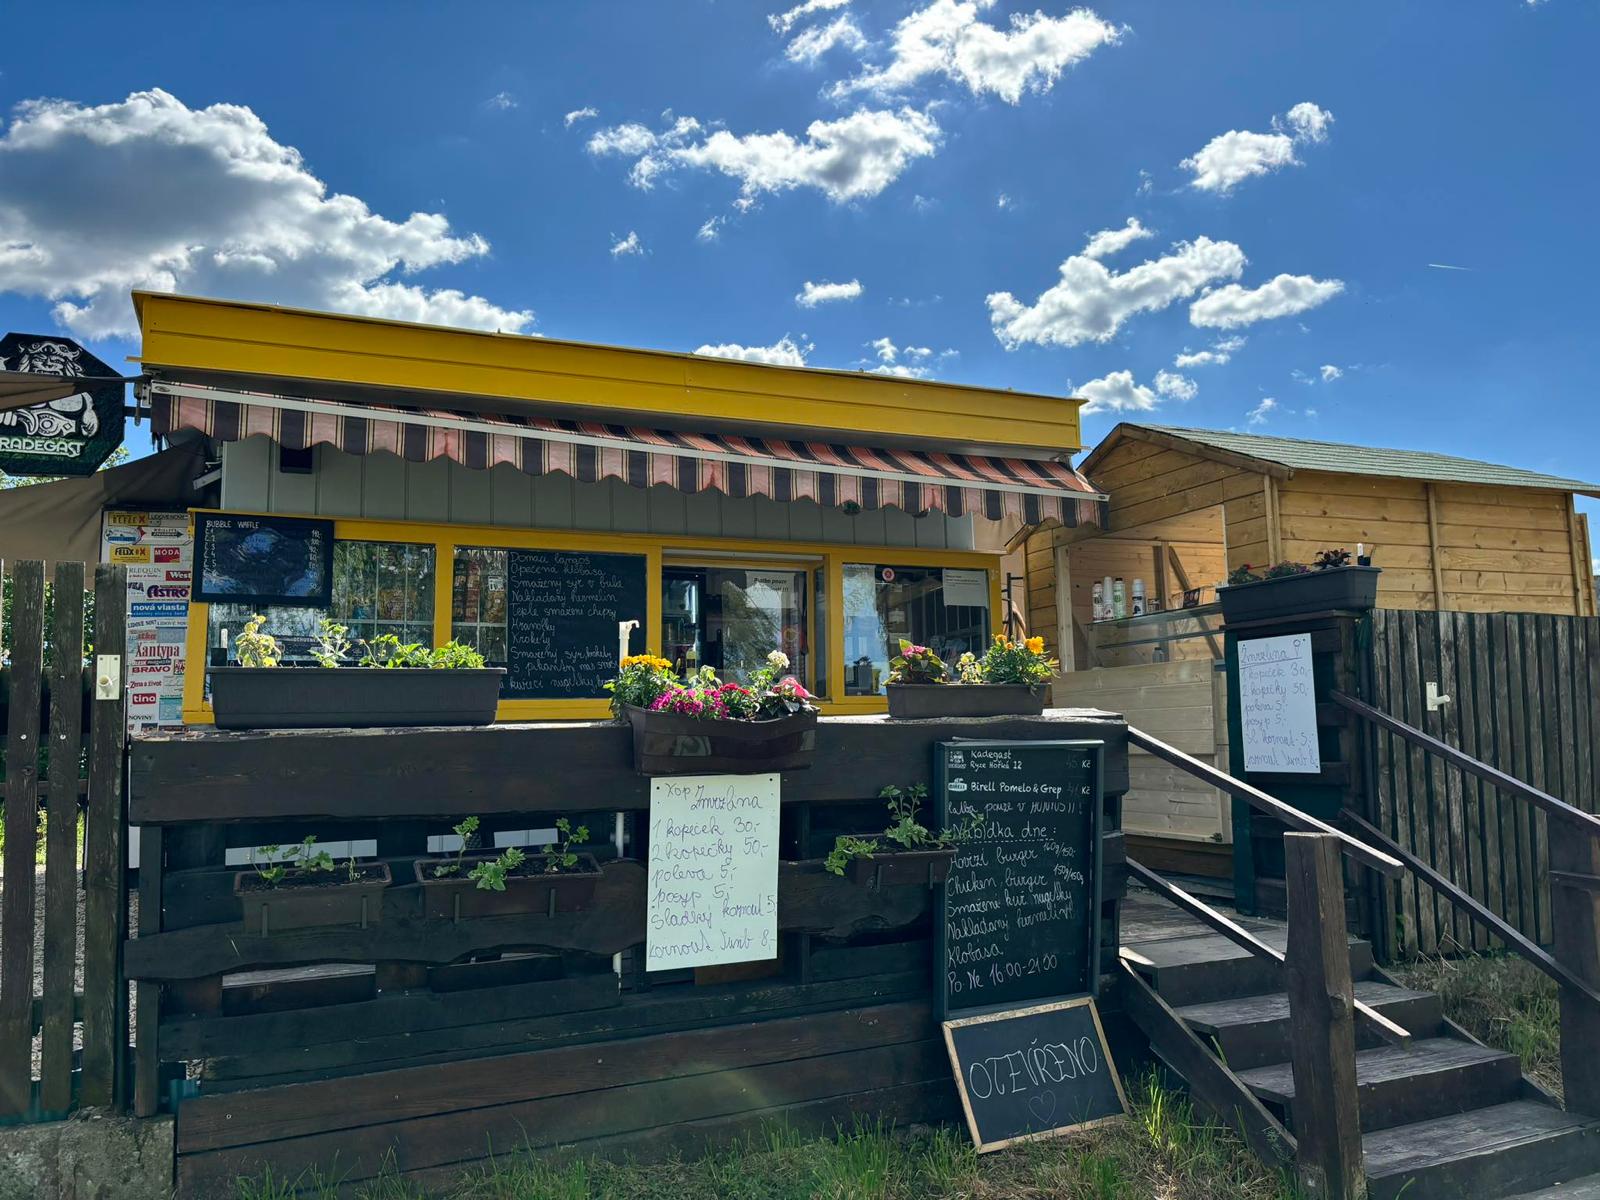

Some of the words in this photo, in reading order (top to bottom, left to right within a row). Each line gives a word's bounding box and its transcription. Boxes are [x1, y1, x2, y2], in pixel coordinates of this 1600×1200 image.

[0, 437, 86, 458] RADEGAST
[206, 520, 232, 529] BUBBLE
[238, 521, 259, 529] WAFFLE
[147, 585, 189, 599] ASTRO
[132, 666, 171, 674] BRAVO
[133, 694, 156, 703] tino
[1013, 760, 1022, 770] 12
[1081, 759, 1092, 769] Kč
[970, 781, 996, 792] Birell
[999, 781, 1032, 794] Pomelo
[1032, 784, 1039, 794] &
[1039, 785, 1062, 799] Grep
[1081, 785, 1091, 795] Kč
[952, 821, 1015, 840] Nabídka
[1021, 820, 1048, 839] dne
[651, 843, 664, 861] 2
[996, 847, 1039, 868] burger
[948, 870, 997, 897] Chicken
[1004, 867, 1049, 893] burger
[652, 888, 702, 909] posyp
[969, 1037, 1098, 1099] OTEVŘENO
